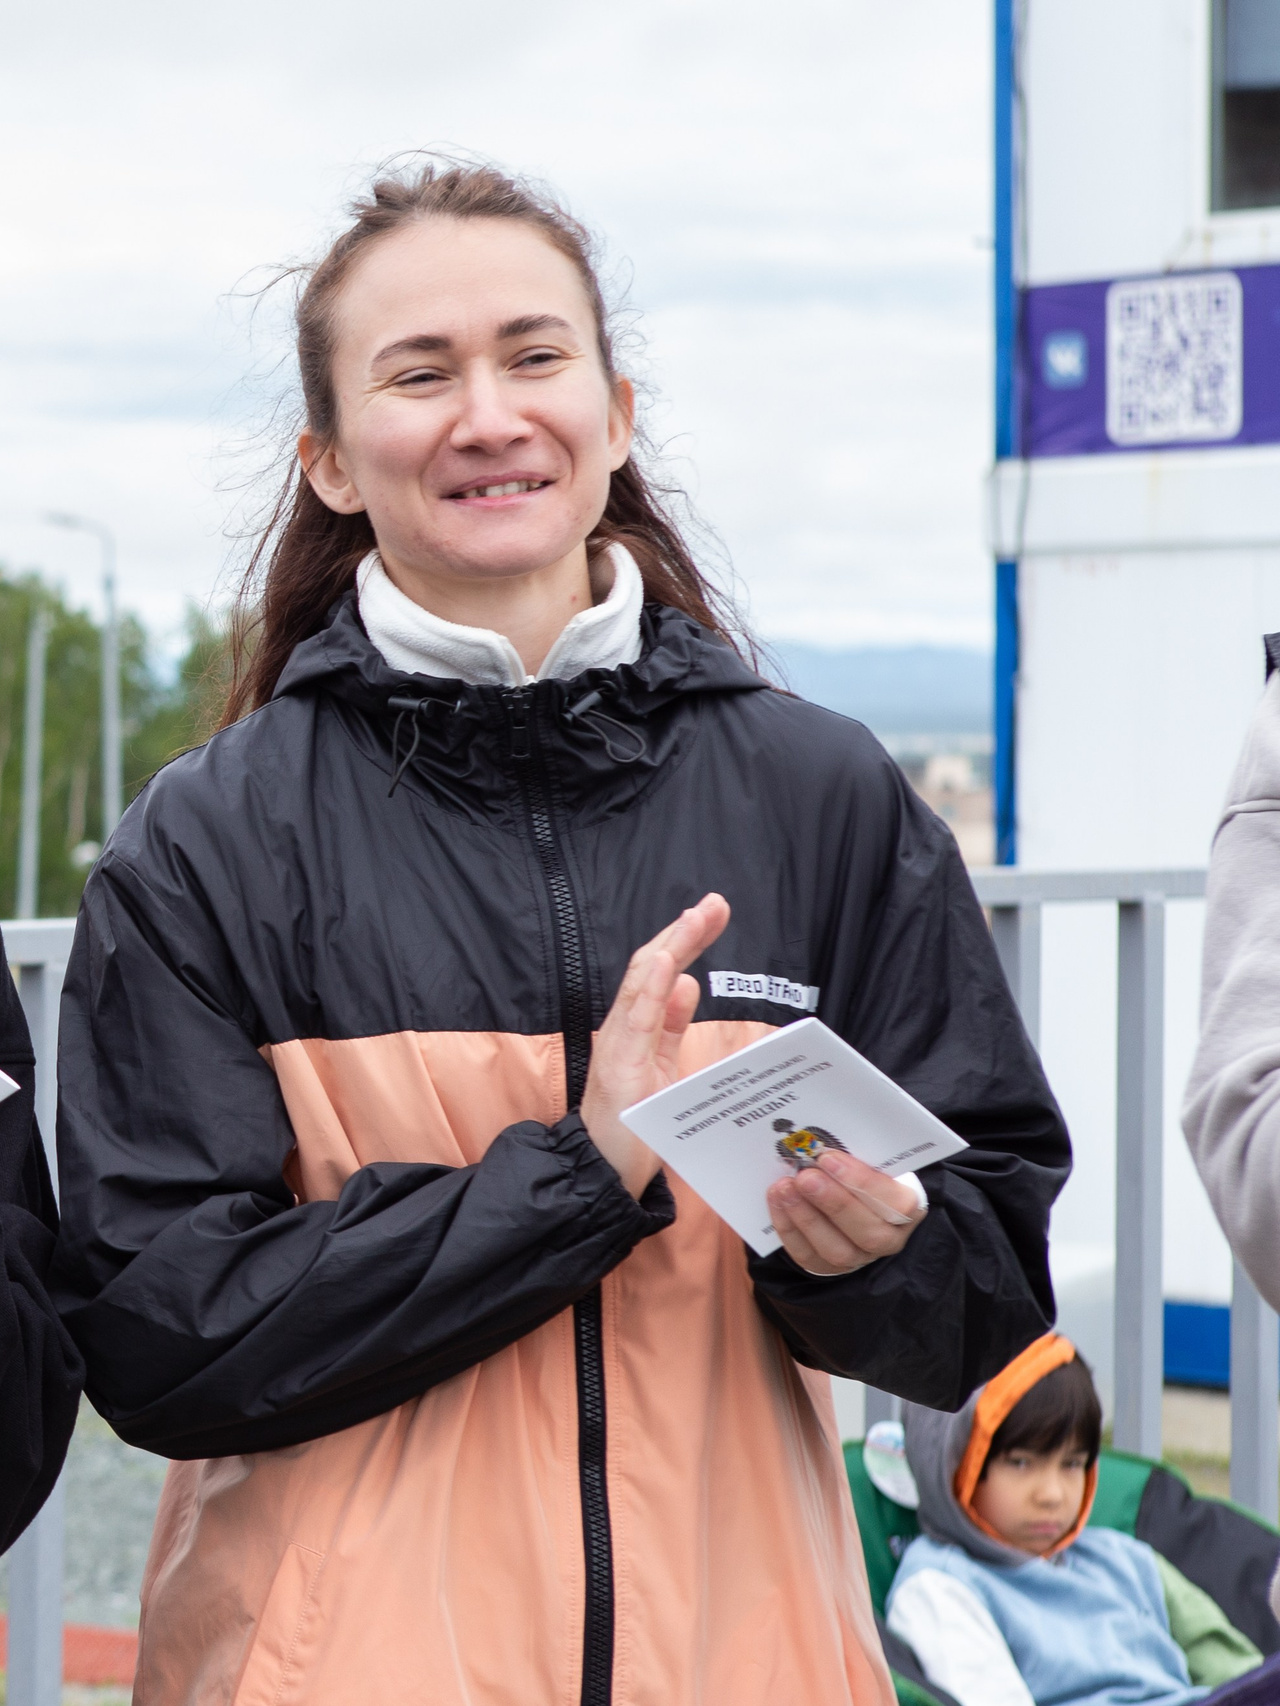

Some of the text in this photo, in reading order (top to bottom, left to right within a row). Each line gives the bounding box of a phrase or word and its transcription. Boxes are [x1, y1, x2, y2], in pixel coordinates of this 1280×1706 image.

[674, 1060, 833, 1140] КЛАССИФИКАЦИОННАЯ КНИЖКА
[732, 1091, 800, 1127] ЗАЧЕТНАЯ
